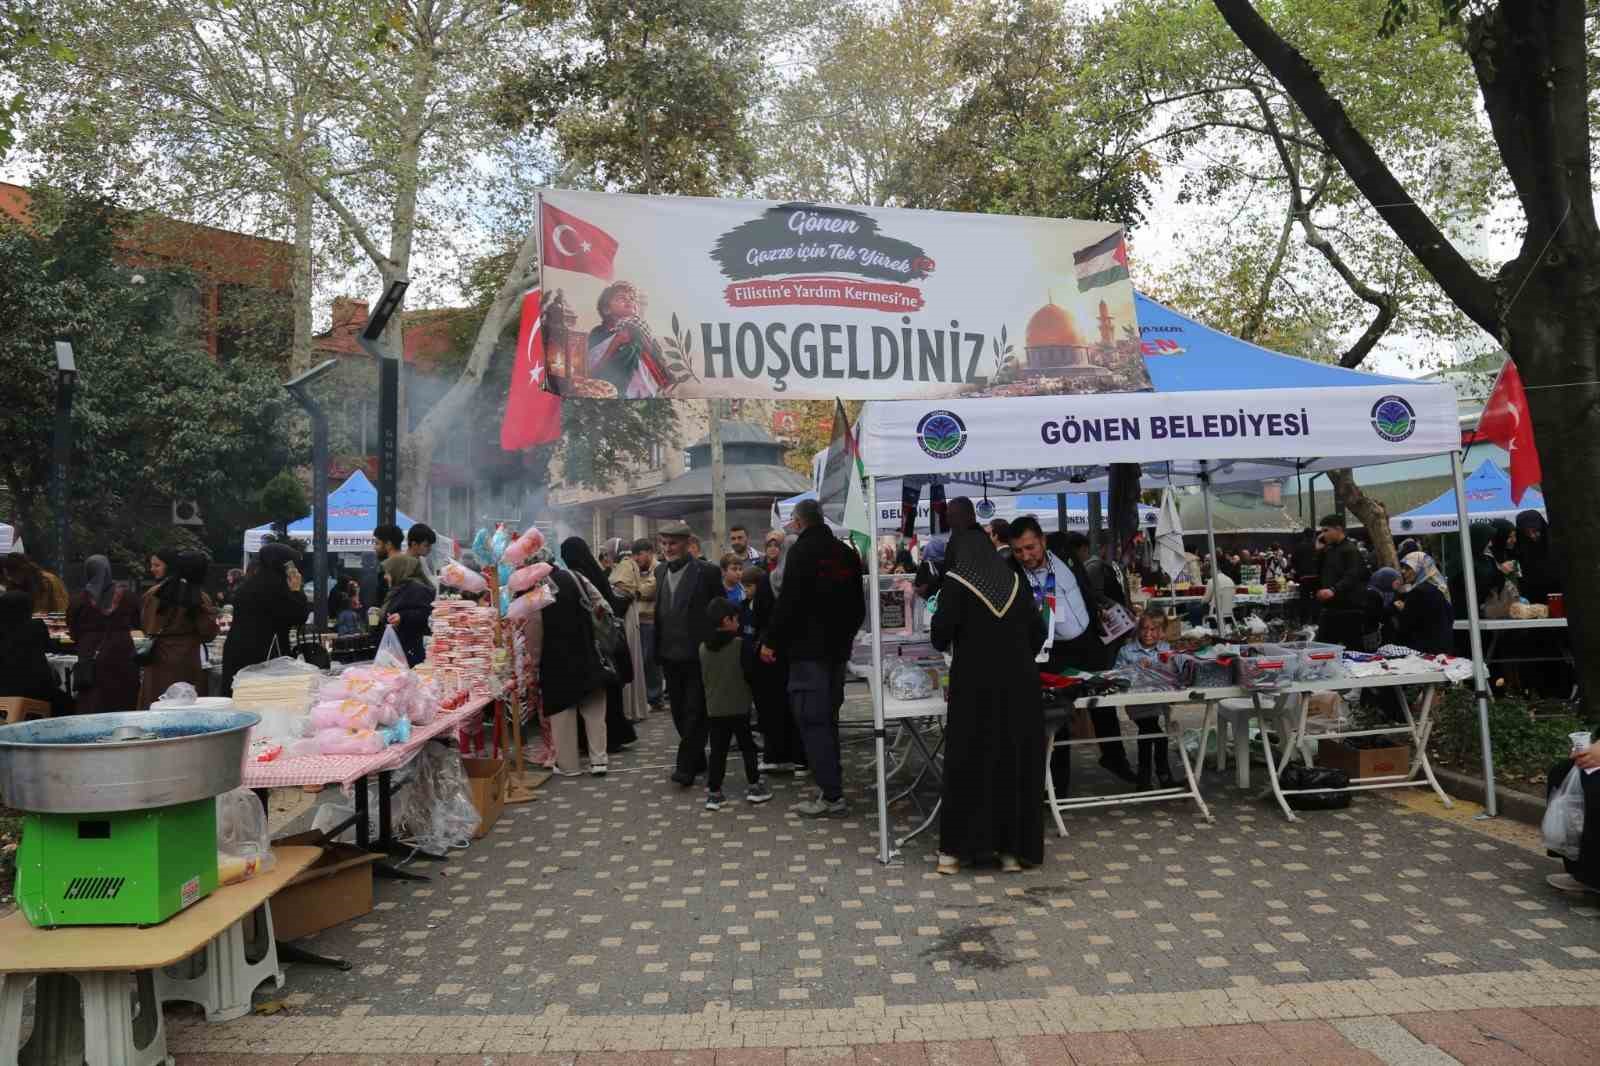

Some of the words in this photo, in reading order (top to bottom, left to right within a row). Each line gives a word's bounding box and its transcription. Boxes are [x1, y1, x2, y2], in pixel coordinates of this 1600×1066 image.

[788, 210, 860, 235] Gönen
[746, 248, 797, 266] Gazze
[797, 243, 827, 262] için
[828, 243, 858, 261] Tek
[857, 247, 912, 273] Yürek
[734, 285, 791, 301] Filistin'e
[793, 284, 841, 299] Yardım
[844, 286, 918, 307] Kermesi'ne
[700, 316, 988, 392] HOŞGELDİNİZ
[1040, 415, 1141, 445] GÖNEN
[1150, 407, 1309, 440] BELEDİYESİ
